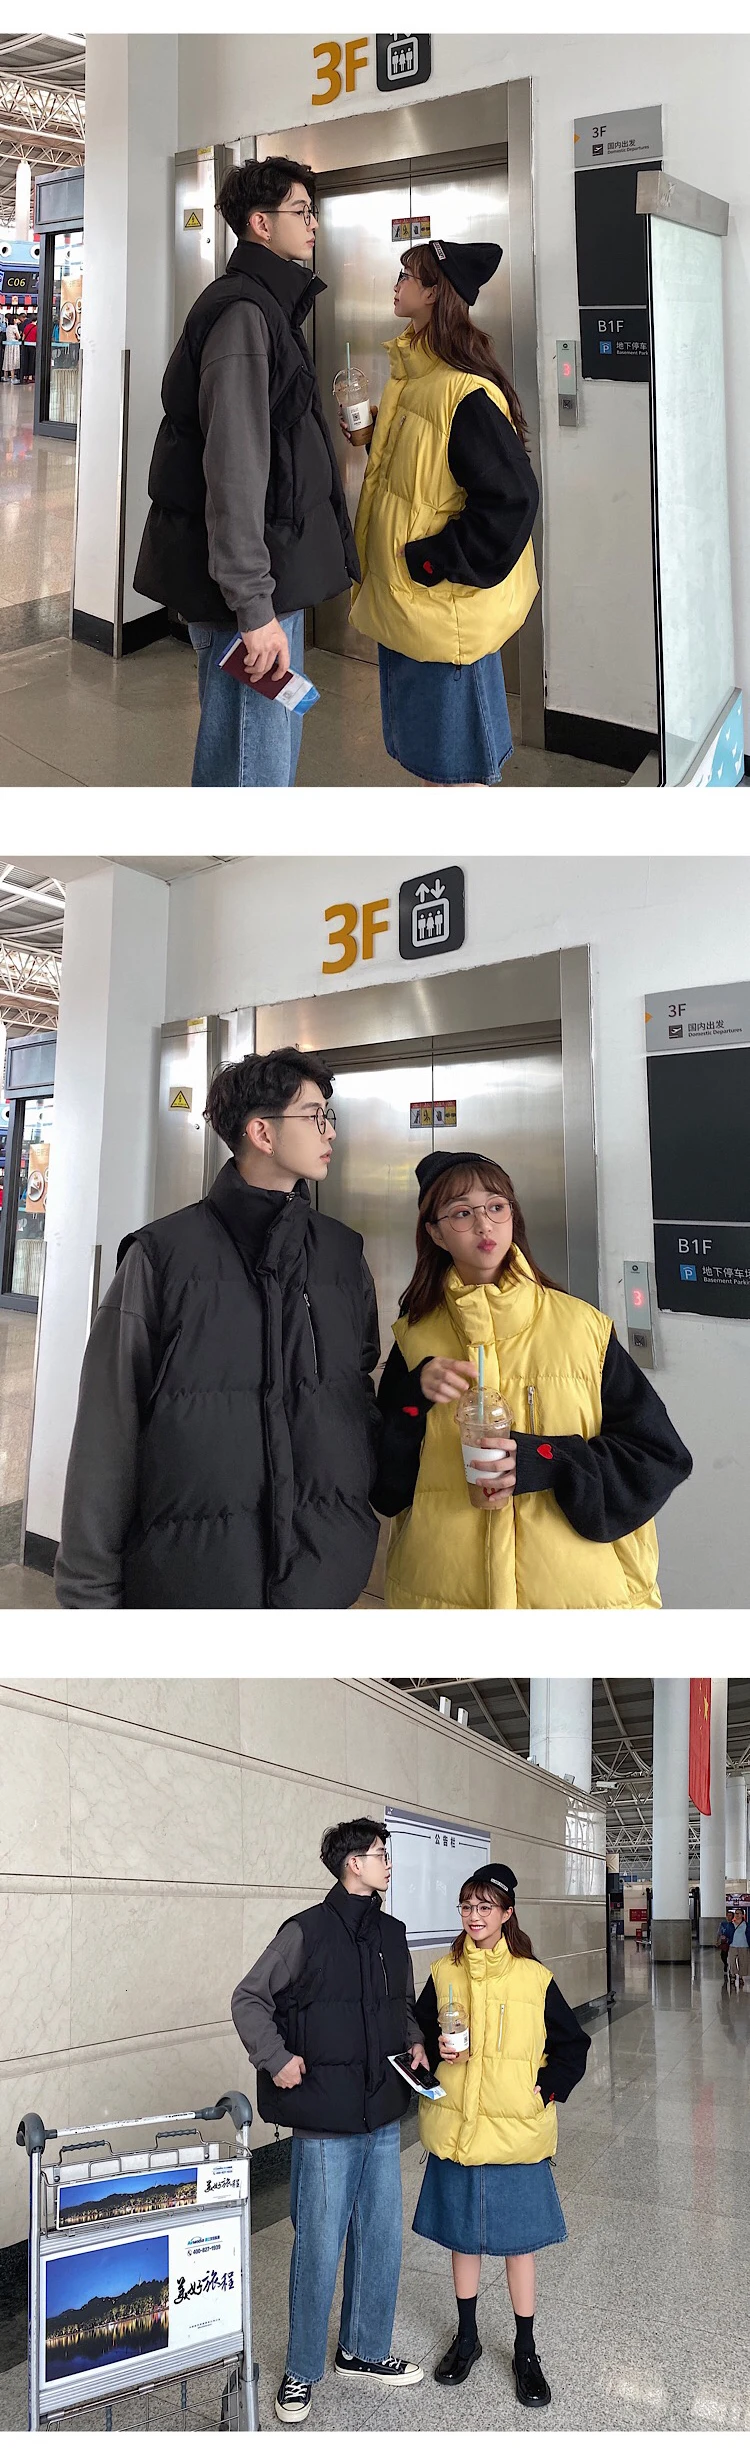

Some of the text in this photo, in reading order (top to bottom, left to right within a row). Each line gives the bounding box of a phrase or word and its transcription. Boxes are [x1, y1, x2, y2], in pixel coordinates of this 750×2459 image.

[311, 37, 368, 105] 3F
[592, 126, 607, 138] 3F
[607, 139, 636, 150] 国内出发
[626, 145, 649, 153] Departures
[7, 278, 26, 287] C06
[598, 320, 624, 332] B1F
[616, 342, 647, 350] 地下停车
[563, 363, 571, 376] 3
[322, 898, 389, 974] 3F
[668, 1003, 687, 1018] 3F
[688, 1020, 725, 1032] 国内出发
[713, 1027, 743, 1035] Departures
[678, 1238, 712, 1255] B1F
[703, 1277, 733, 1285] Basement
[633, 1290, 643, 1306] 3
[435, 1834, 456, 1848] 公告栏
[204, 2178, 240, 2193] 美好旅程
[173, 2270, 234, 2304] 美好旅程
